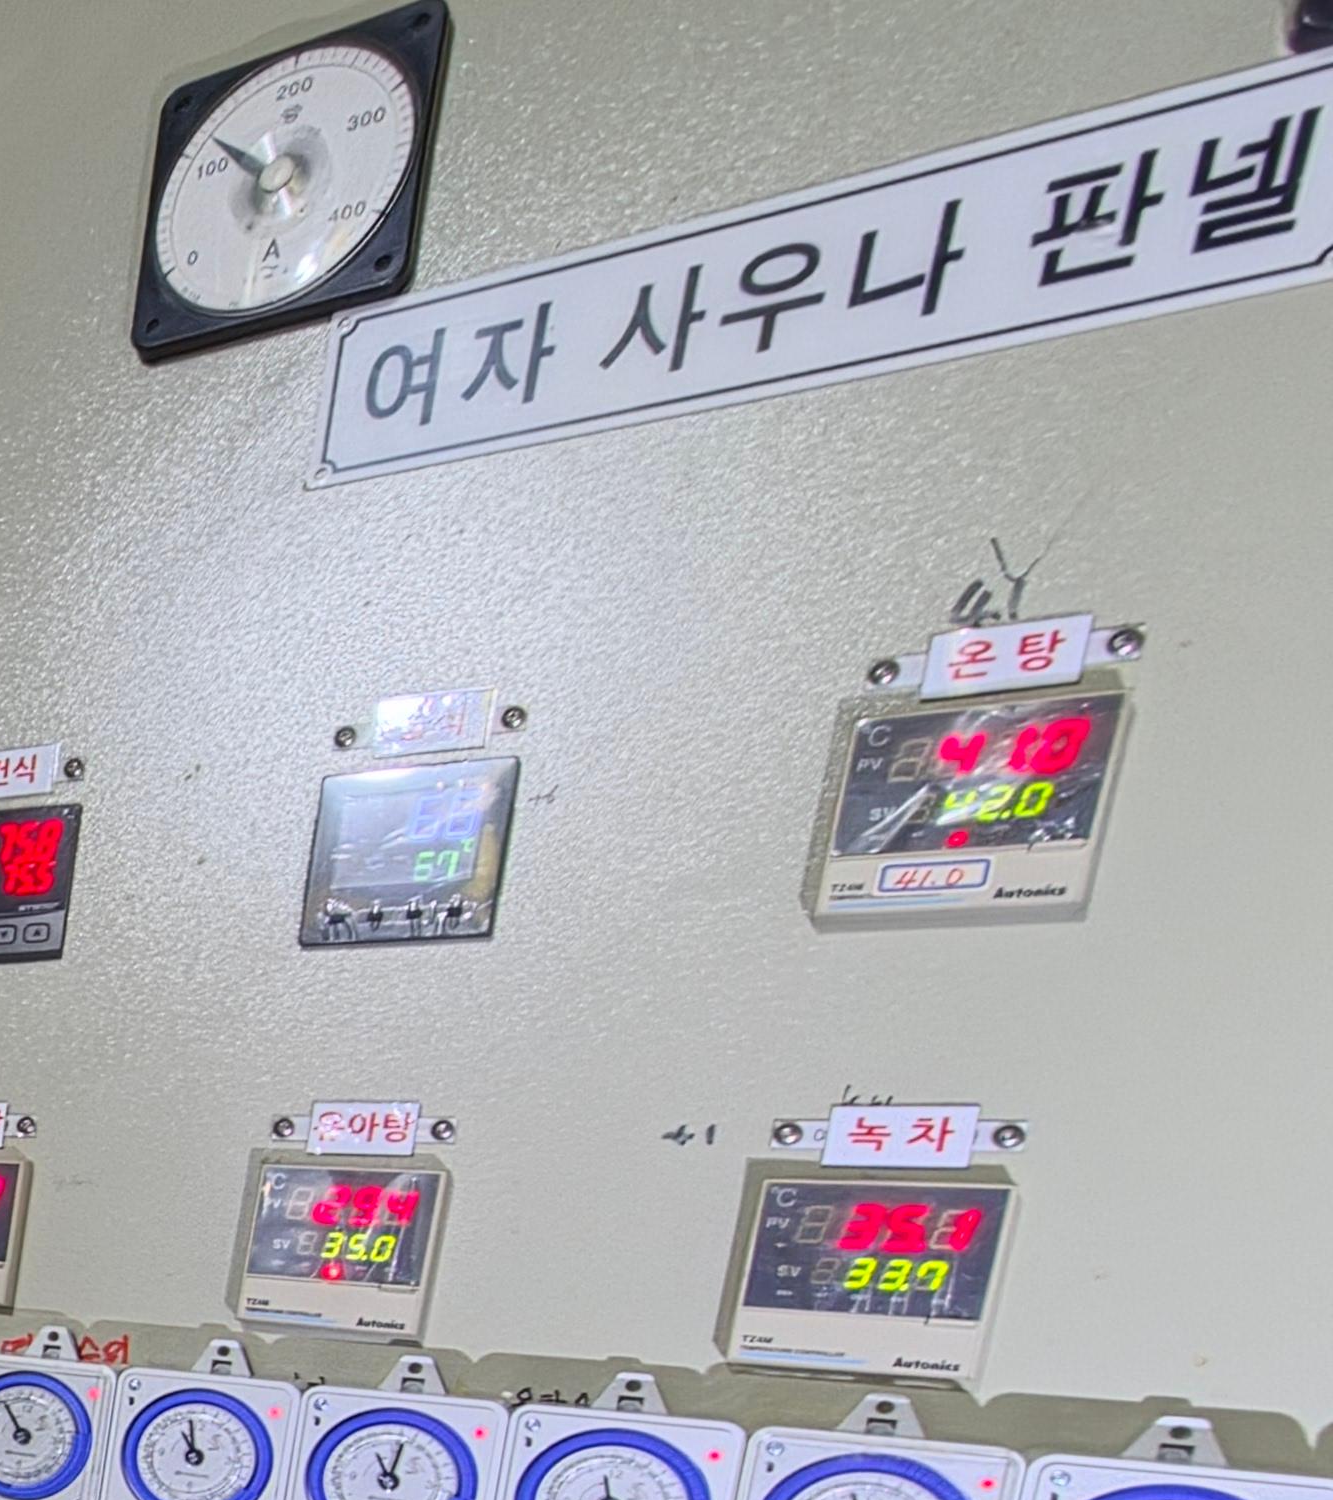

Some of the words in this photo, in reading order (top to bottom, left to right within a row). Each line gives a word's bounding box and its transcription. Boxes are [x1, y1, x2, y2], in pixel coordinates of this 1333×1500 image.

[277, 76, 314, 102] 200
[346, 107, 386, 132] 300
[196, 157, 228, 179] 100
[327, 200, 367, 222] 400
[187, 251, 198, 265] 0
[365, 302, 558, 425] 여자
[598, 200, 964, 378] 사우나
[1028, 105, 1323, 289] 판넬
[992, 884, 1068, 900] Autonics
[356, 1317, 405, 1331] Autonics
[892, 1357, 961, 1373] Autonics
